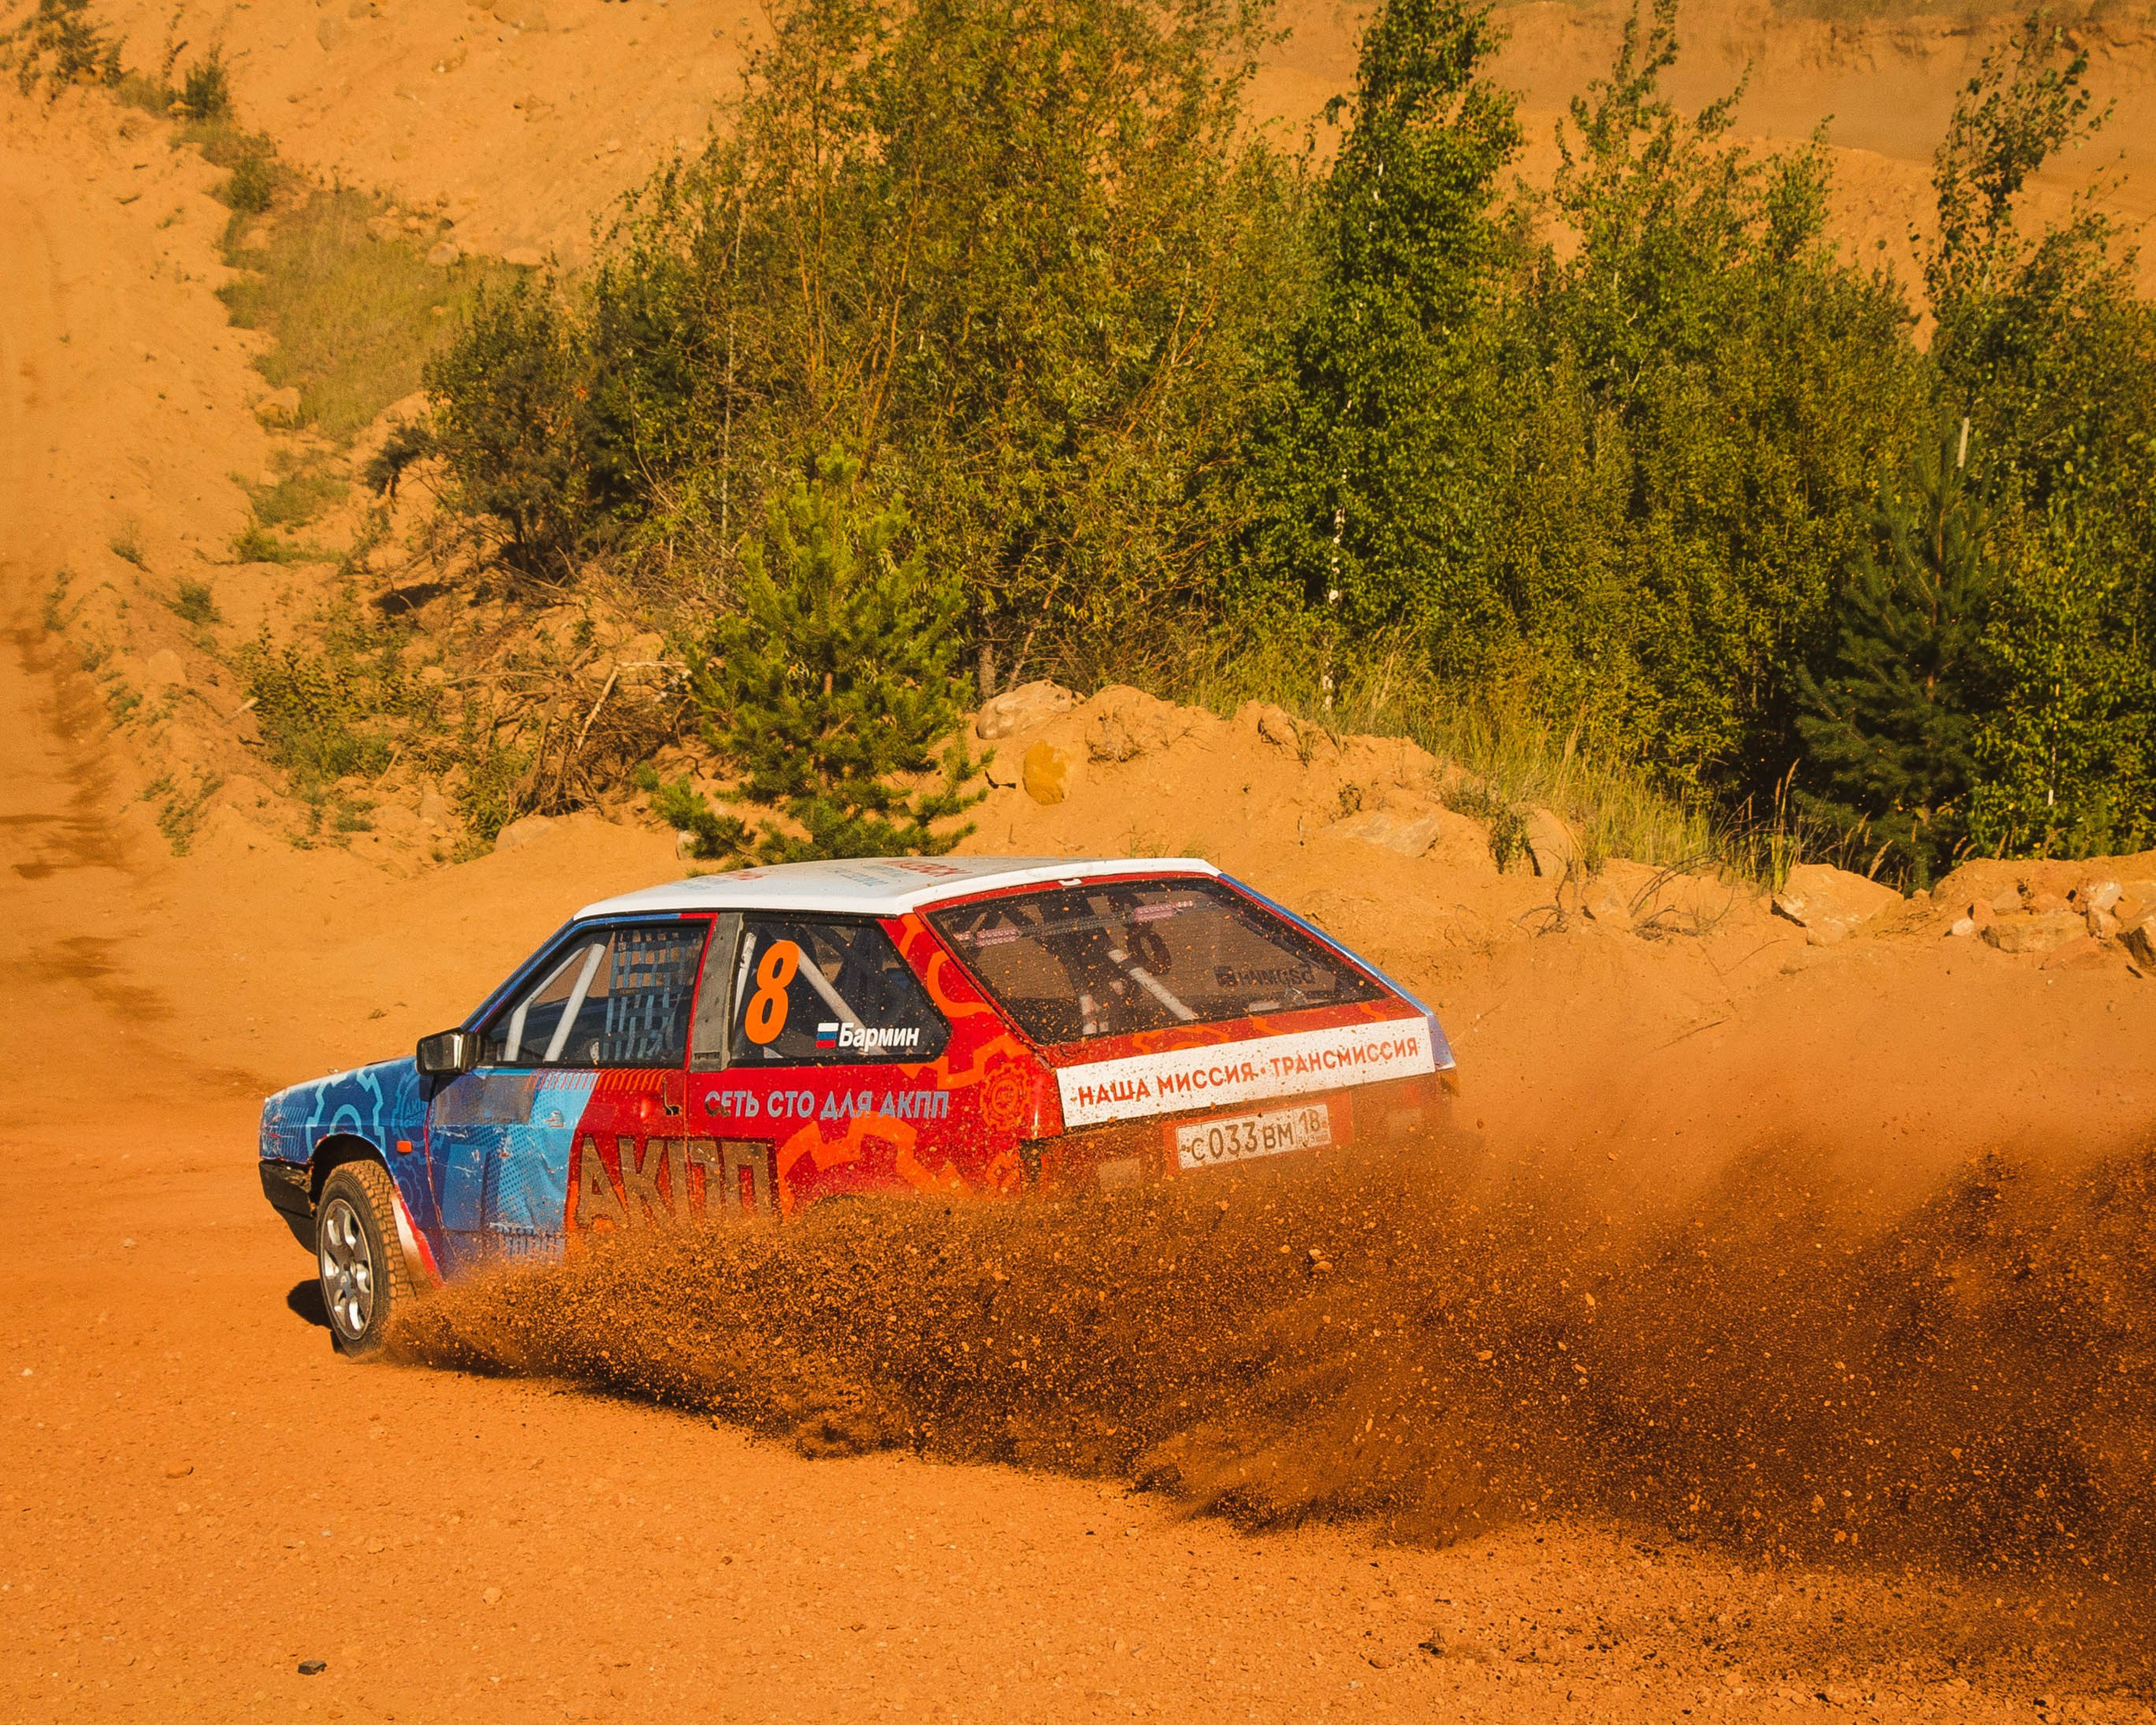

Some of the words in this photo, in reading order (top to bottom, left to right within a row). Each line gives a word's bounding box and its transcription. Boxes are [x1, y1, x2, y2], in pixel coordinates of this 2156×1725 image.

[744, 940, 800, 1044] 8
[839, 1023, 920, 1052] Бармин
[1077, 1078, 1151, 1108] НАША
[1156, 1062, 1254, 1098] МИССИЯ
[1270, 1037, 1419, 1077] ТРАНСМИССИЯ
[705, 1090, 760, 1117] СЕТЬ
[767, 1090, 814, 1118] СТО
[819, 1090, 873, 1120] ДЛЯ
[878, 1090, 949, 1119] АКПП
[576, 1136, 773, 1227] АКПП
